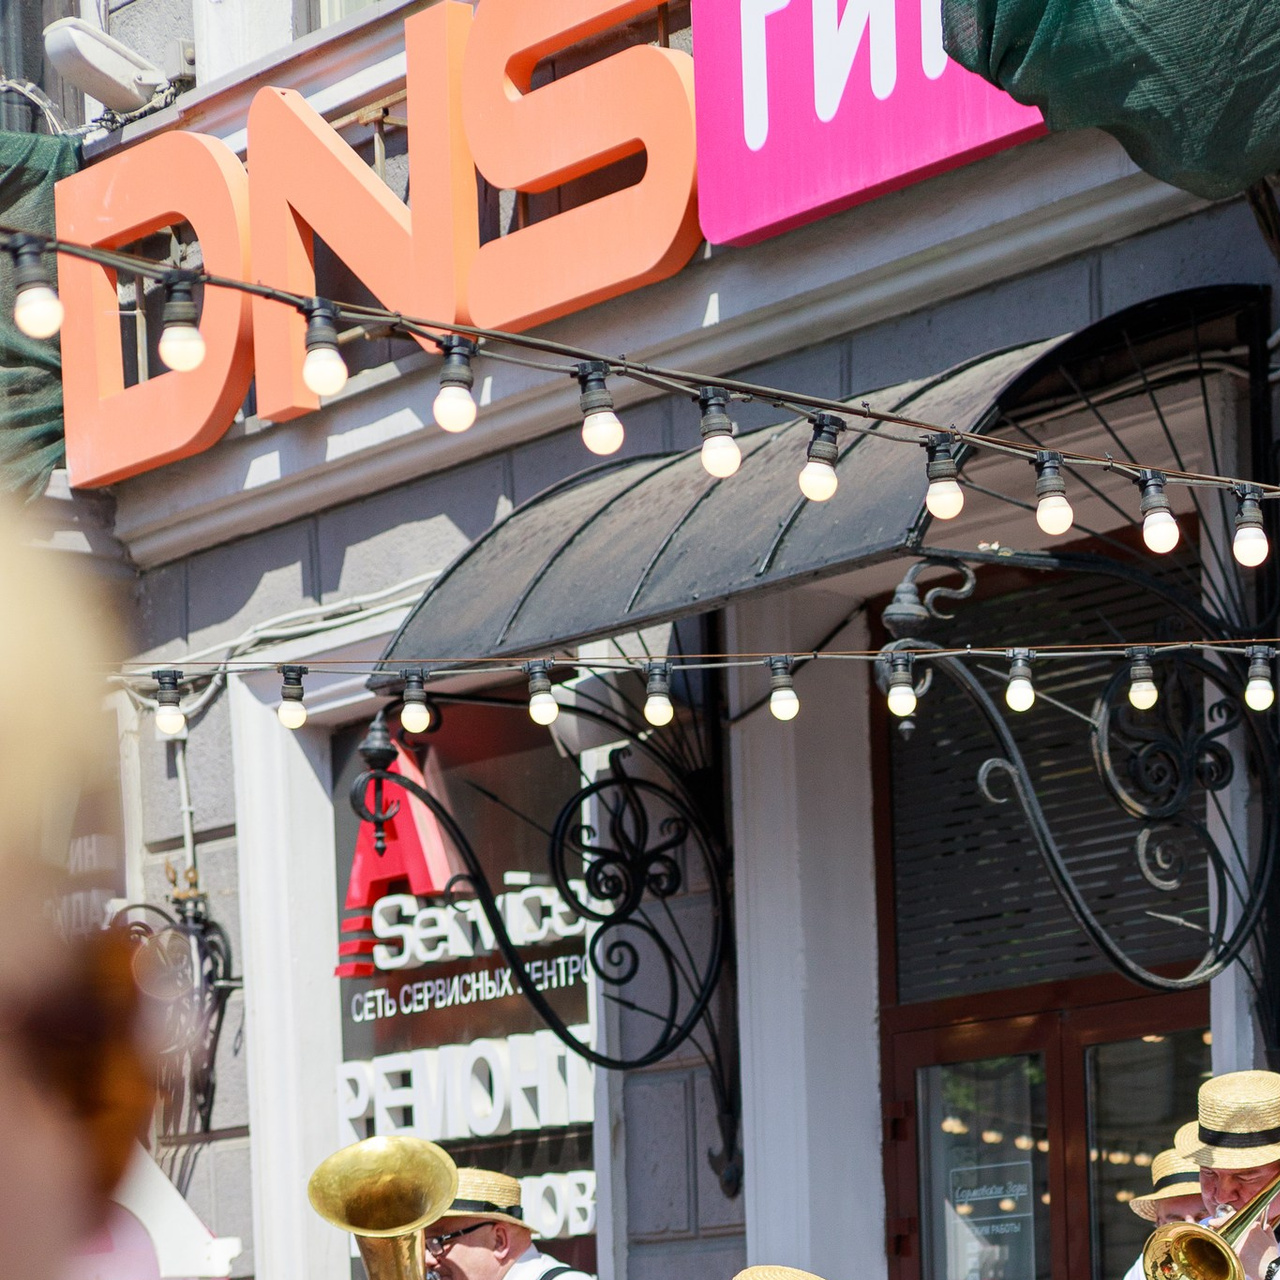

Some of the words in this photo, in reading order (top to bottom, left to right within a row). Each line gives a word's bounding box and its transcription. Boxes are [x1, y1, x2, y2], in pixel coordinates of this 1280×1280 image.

[55, 0, 697, 489] DNS
[351, 987, 397, 1023] СЕТЬ
[400, 967, 514, 1015] СЕРВИСНЫХ
[337, 1023, 595, 1148] РЕМОНТ
